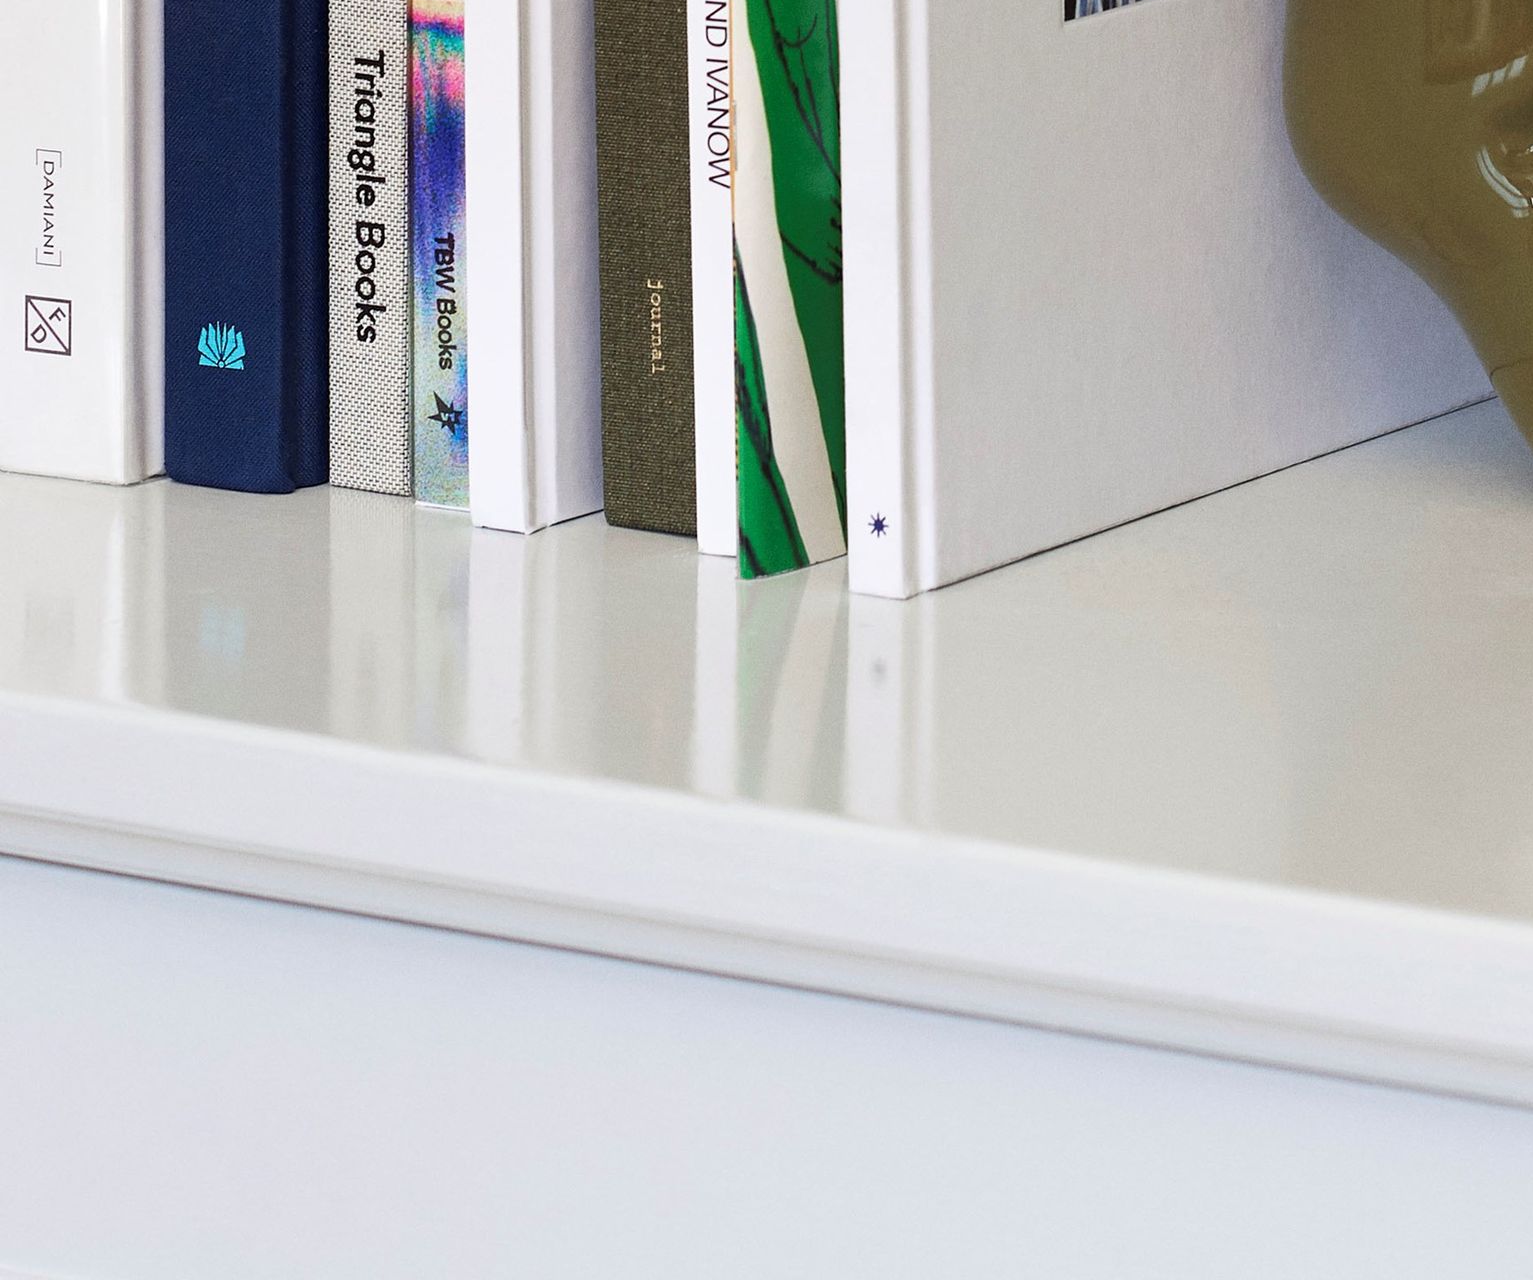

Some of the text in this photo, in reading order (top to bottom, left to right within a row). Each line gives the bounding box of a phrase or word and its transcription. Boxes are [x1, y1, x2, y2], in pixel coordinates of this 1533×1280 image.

[704, 58, 731, 190] IVANOW
[345, 50, 386, 345] Triangle Books
[433, 233, 457, 372] TBW Books
[646, 278, 665, 376] journal
